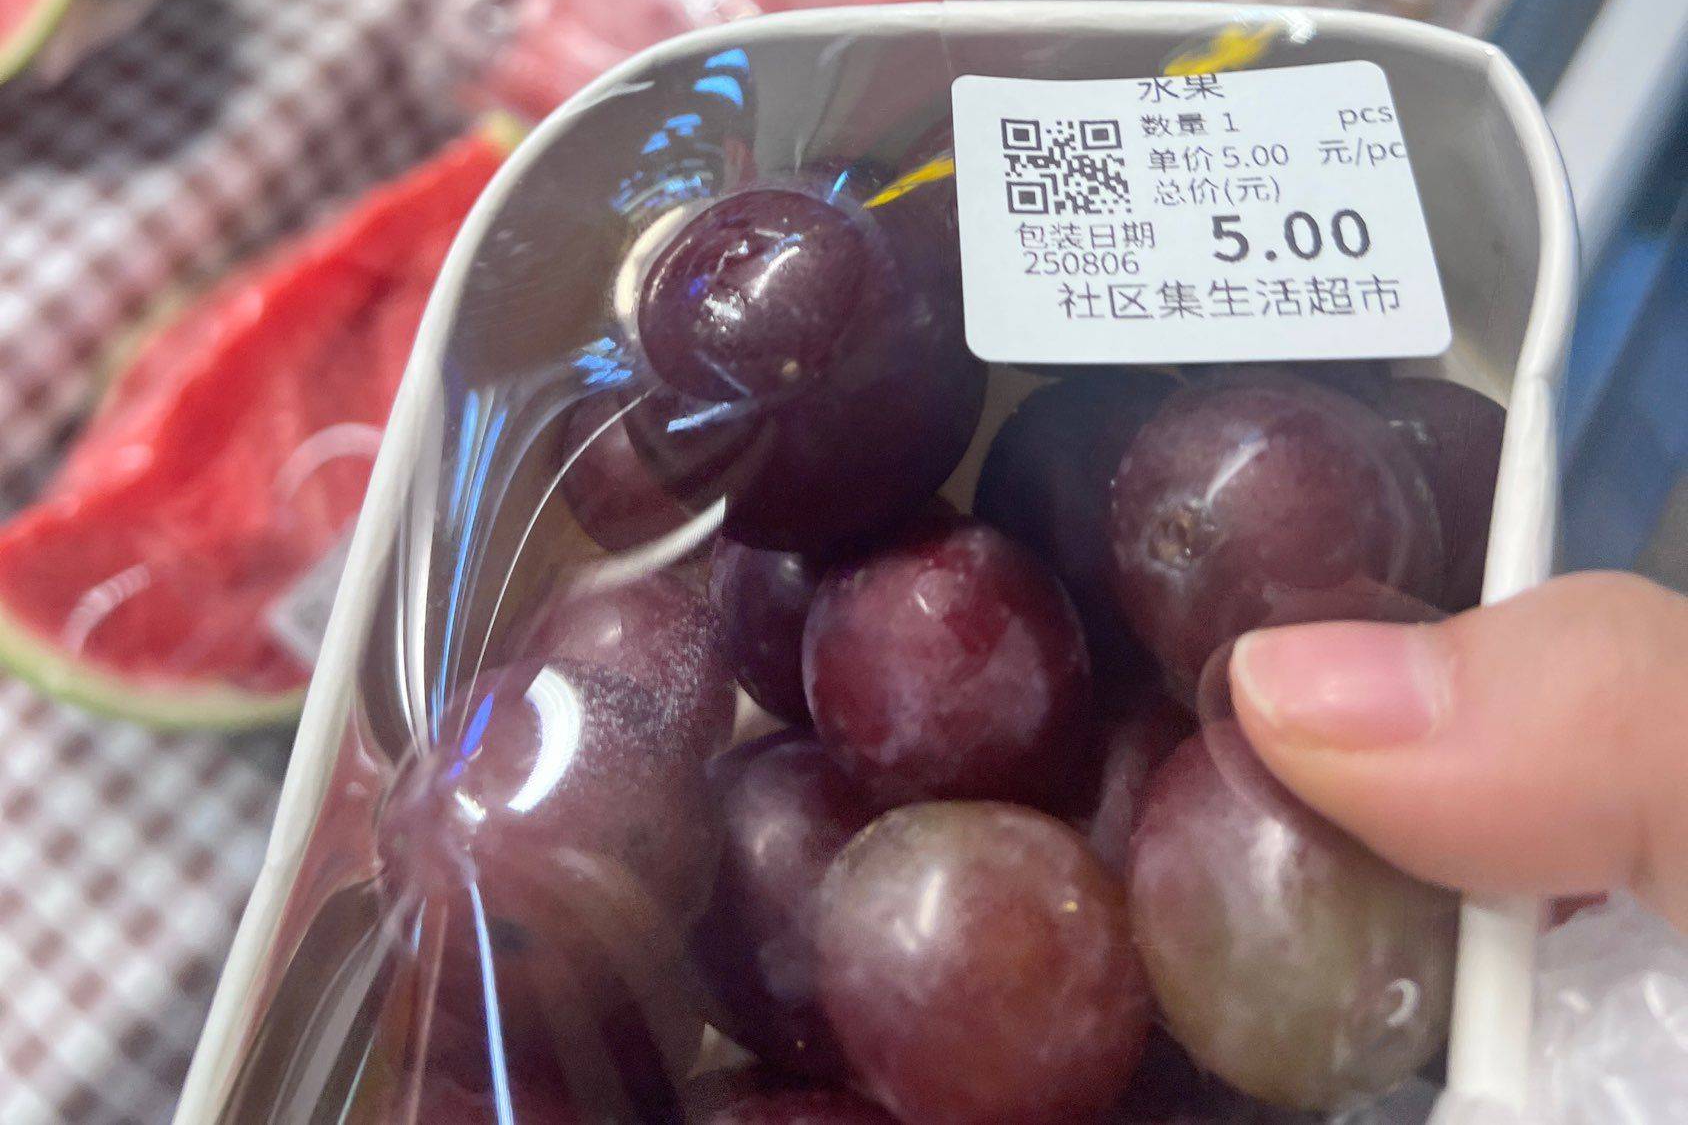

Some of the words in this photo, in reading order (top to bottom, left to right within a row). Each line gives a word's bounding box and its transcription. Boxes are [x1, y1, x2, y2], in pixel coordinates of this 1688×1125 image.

[1140, 113, 1209, 137] 数量
[1223, 111, 1240, 133] 1
[1338, 103, 1395, 130] pcs
[1222, 143, 1290, 168] 5.00
[1153, 177, 1281, 206] 总价(元)
[1015, 220, 1156, 251] 包装日期
[1211, 208, 1372, 264] 5.00
[1023, 251, 1140, 276] 250806
[1057, 274, 1401, 321] 社区集生活超市
